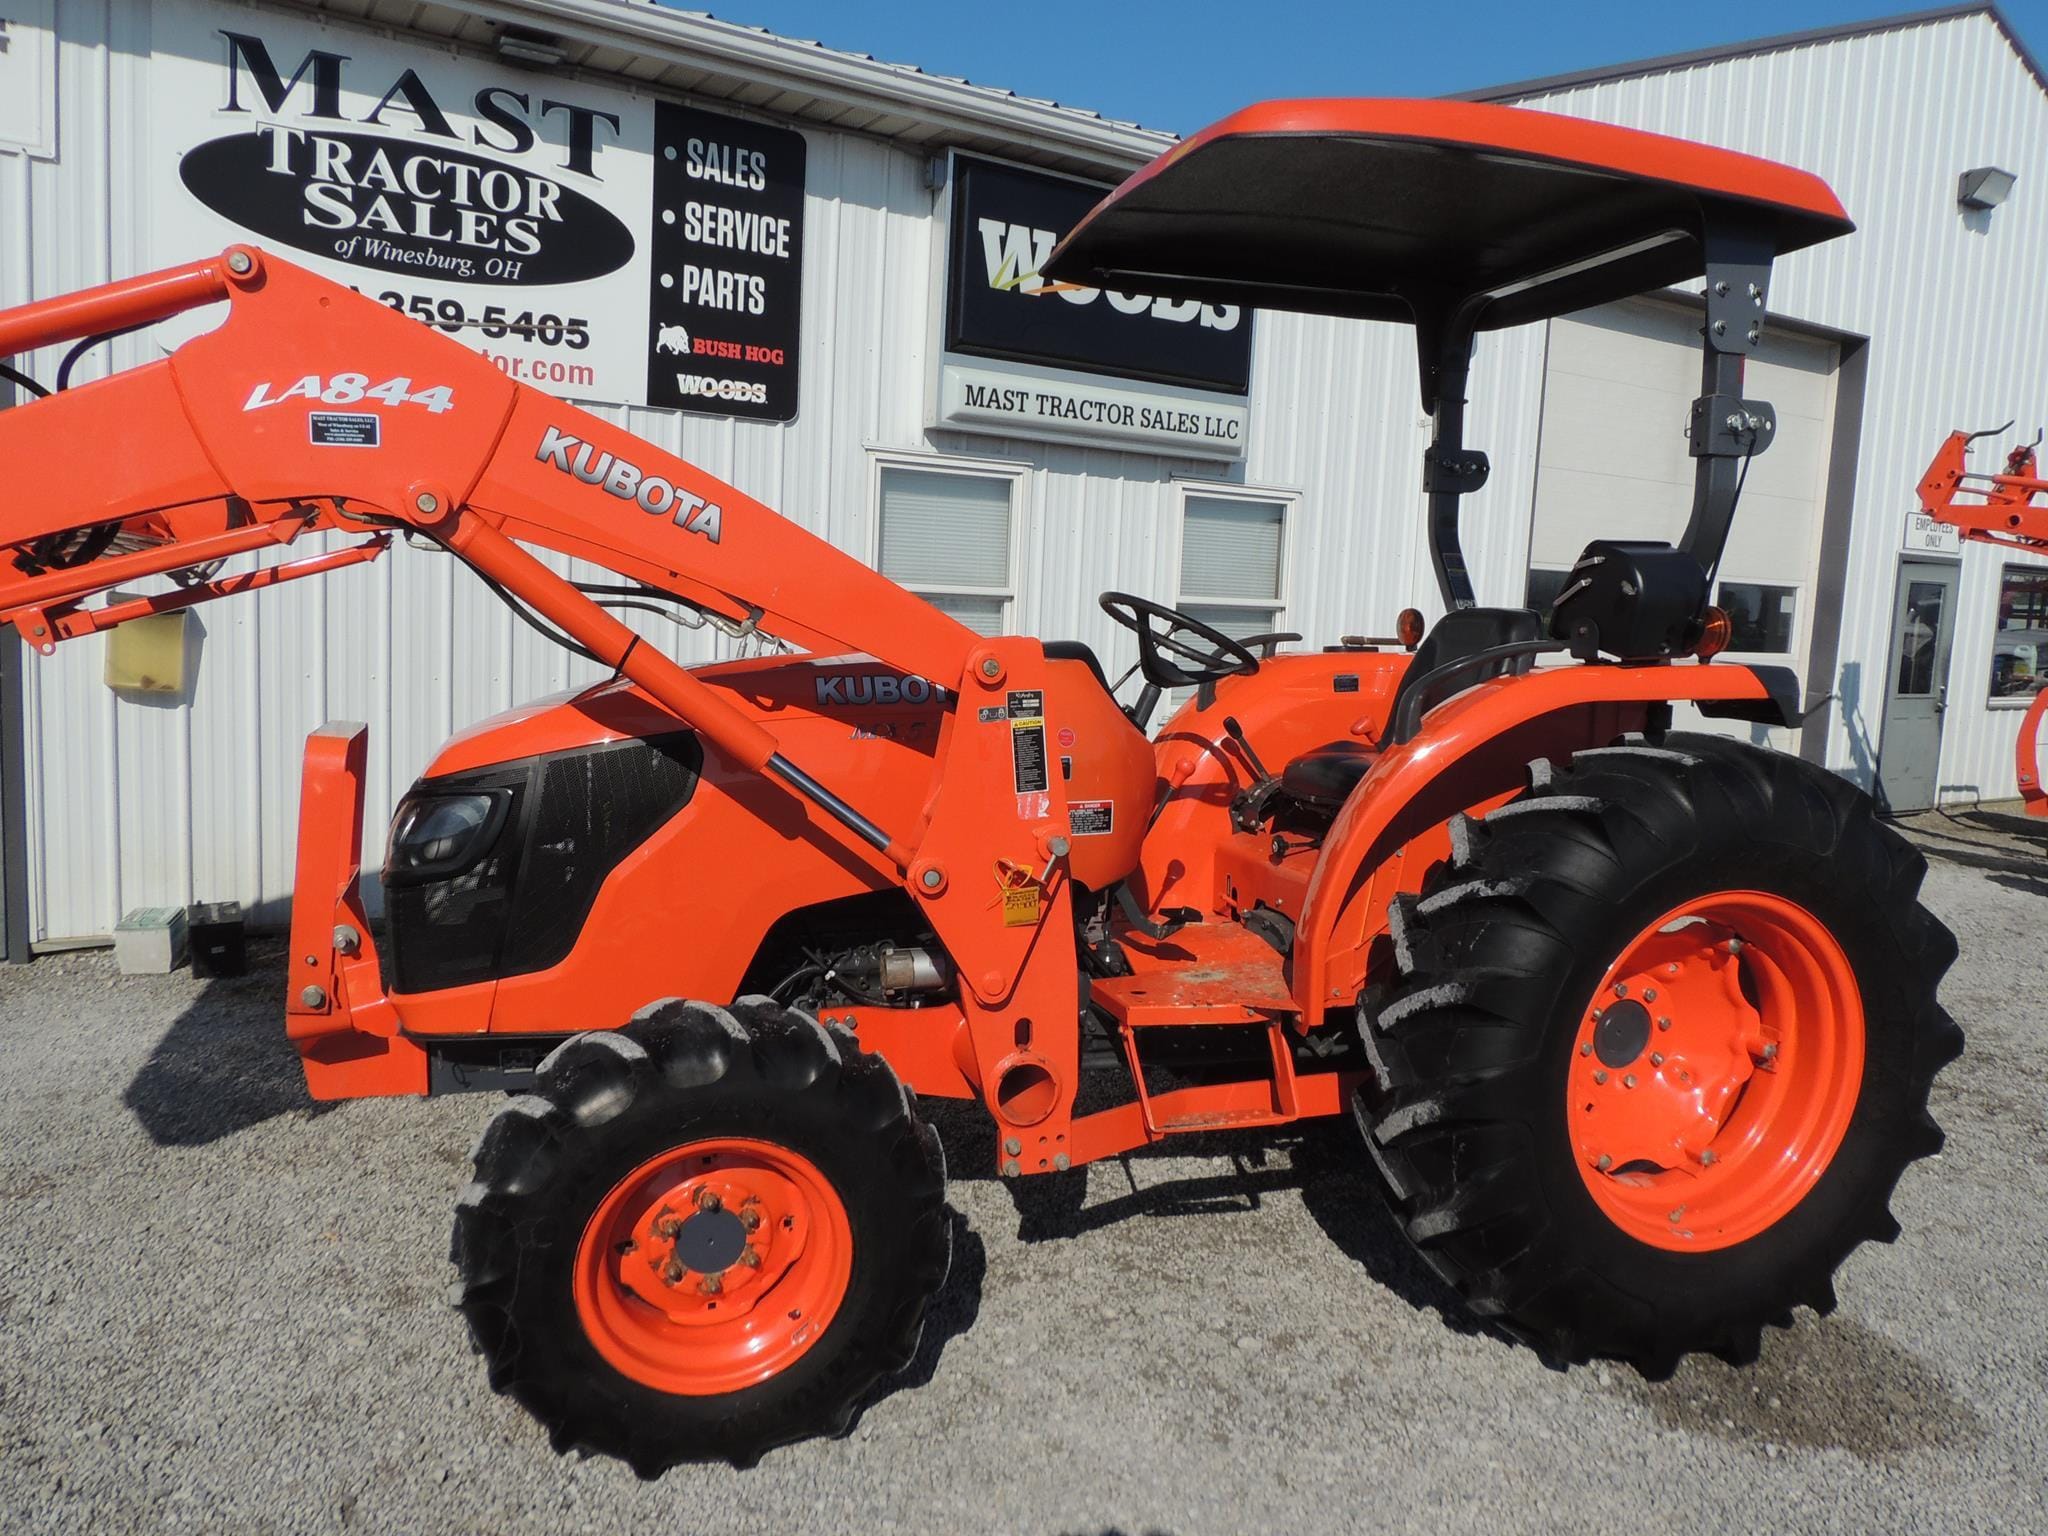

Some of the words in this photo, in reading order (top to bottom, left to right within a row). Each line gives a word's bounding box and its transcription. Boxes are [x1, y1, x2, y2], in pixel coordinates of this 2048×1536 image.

[218, 30, 620, 182] MAST
[256, 121, 563, 222] TRACTOR
[686, 138, 766, 191] SALES
[304, 182, 541, 255] SALES
[684, 201, 790, 258] SERVICE
[334, 236, 361, 259] of
[364, 238, 476, 277] Winesburg,
[485, 258, 522, 280] OH
[683, 264, 765, 315] PARTS
[693, 337, 742, 360] BUSH
[745, 345, 784, 365] HOG
[242, 372, 454, 414] LA844
[677, 373, 766, 403] WOODS
[965, 384, 1029, 412] MAST
[1036, 394, 1134, 426] TRACTOR
[1140, 408, 1199, 435] SALES
[1204, 417, 1239, 439] LLC
[535, 425, 722, 545] KUBOTA
[1916, 517, 1953, 534] EMPLOYEES
[1925, 534, 1942, 548] ONLY
